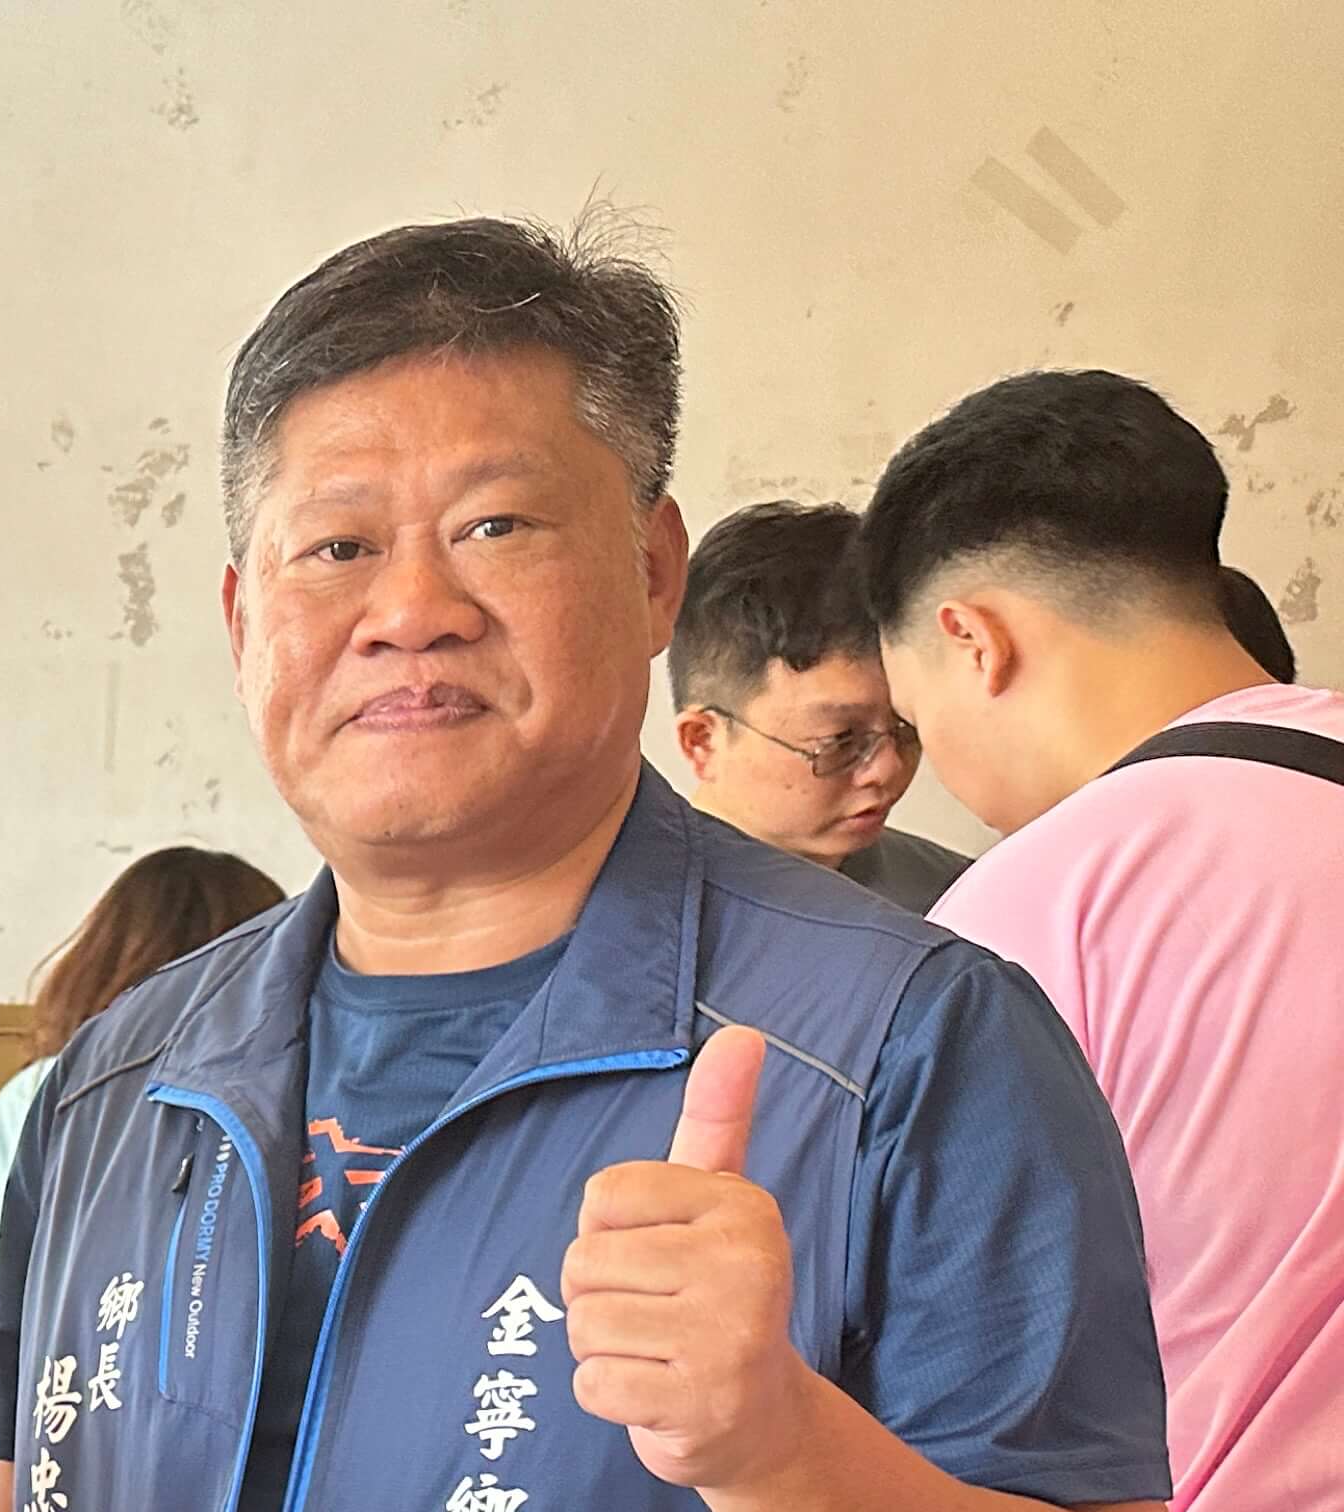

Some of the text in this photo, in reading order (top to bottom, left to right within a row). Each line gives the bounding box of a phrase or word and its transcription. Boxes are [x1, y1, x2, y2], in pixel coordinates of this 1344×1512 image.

[190, 1264, 208, 1298] New
[88, 1272, 145, 1412] 鄉長
[184, 1300, 204, 1360] Outdoor
